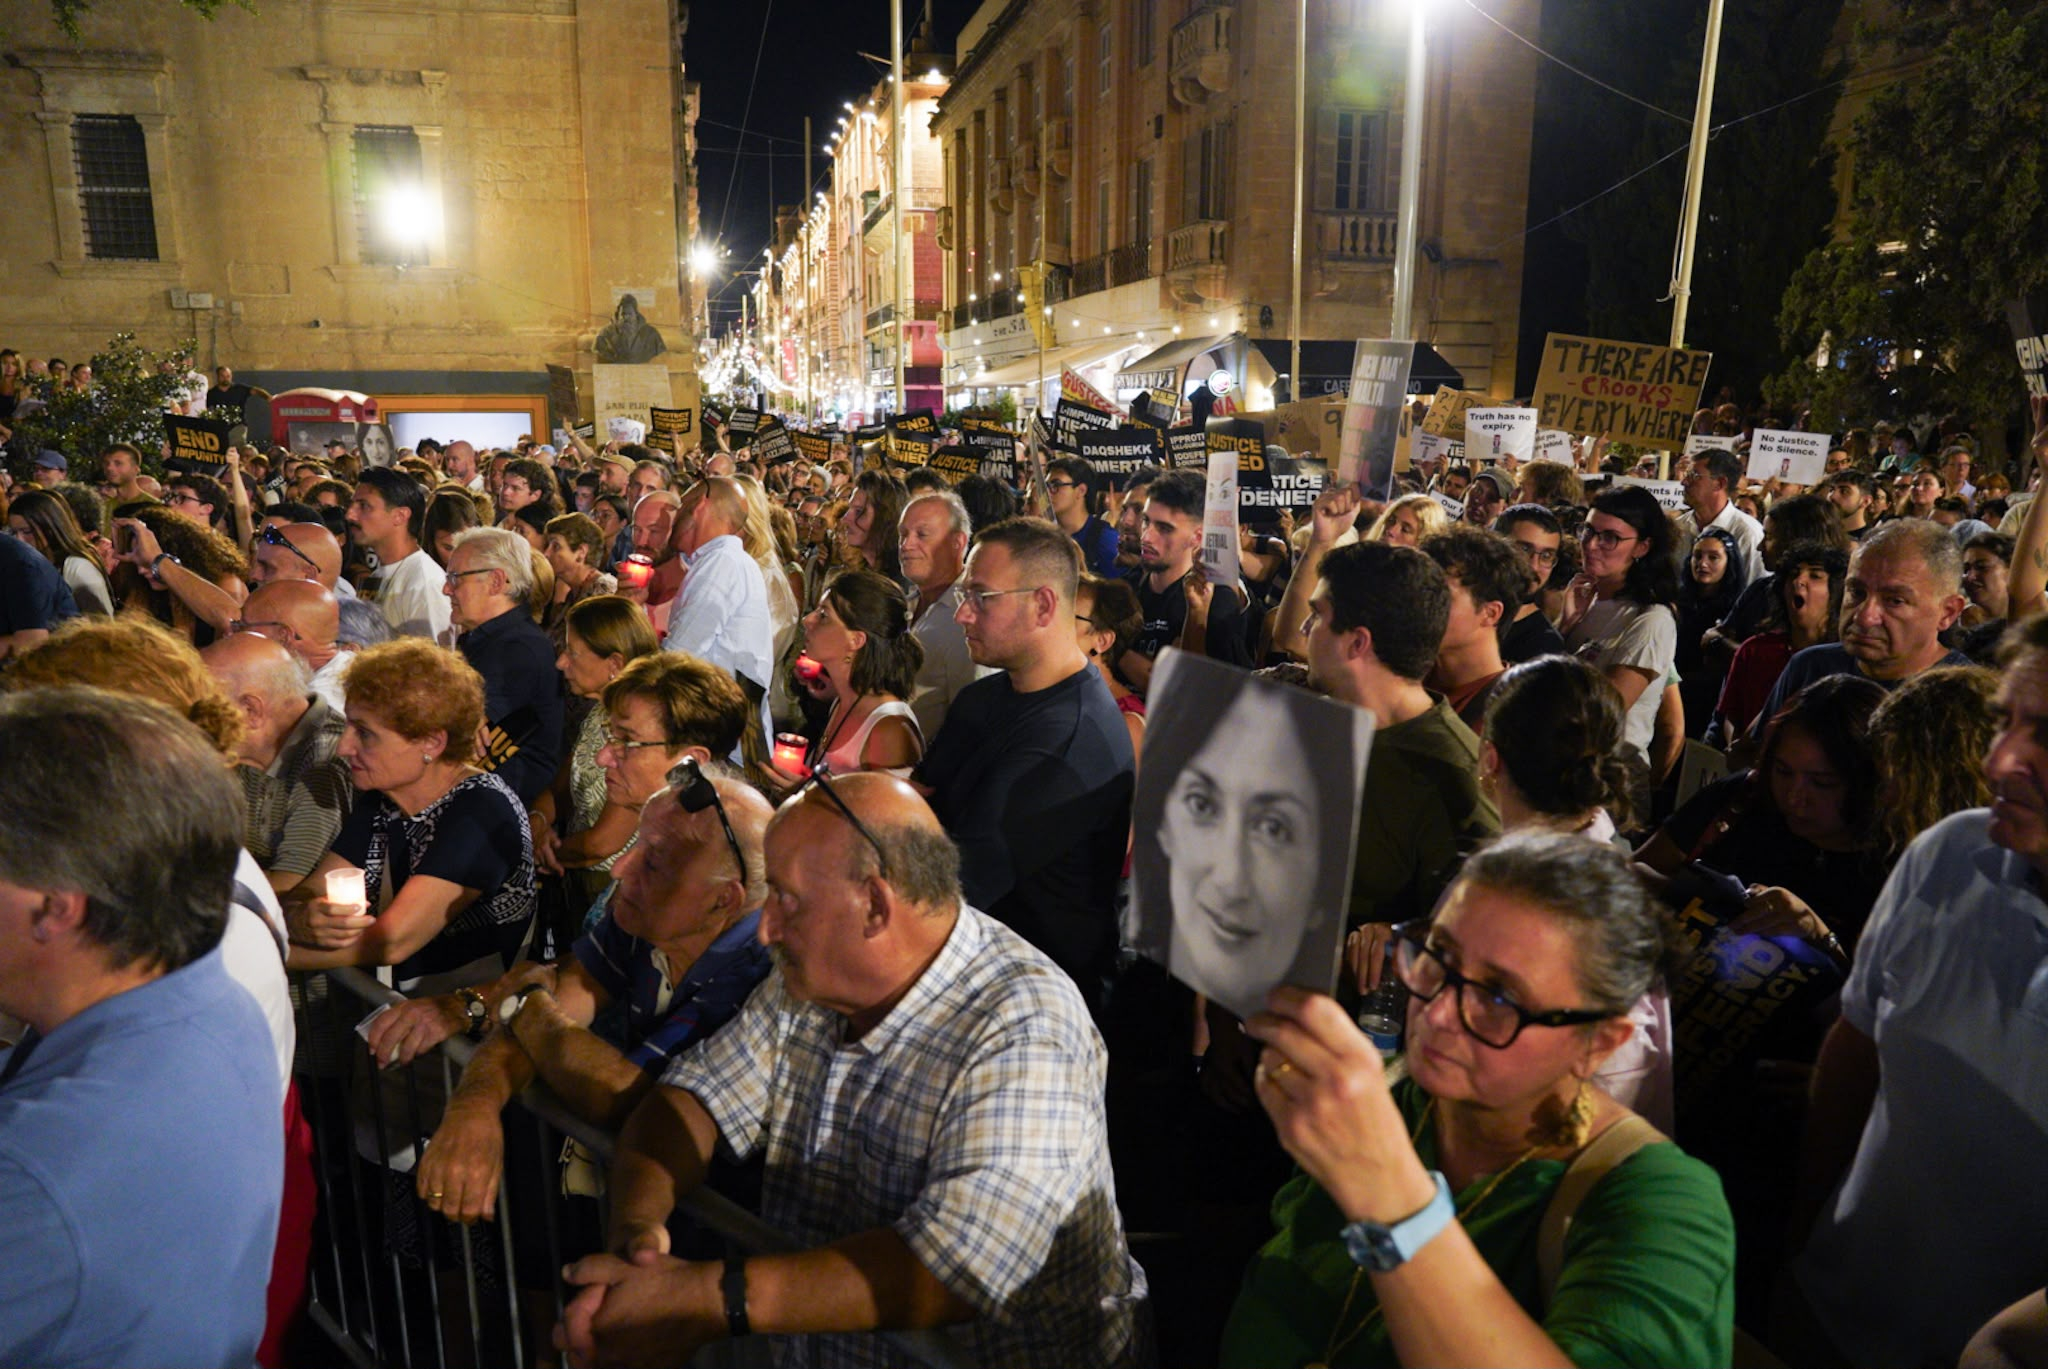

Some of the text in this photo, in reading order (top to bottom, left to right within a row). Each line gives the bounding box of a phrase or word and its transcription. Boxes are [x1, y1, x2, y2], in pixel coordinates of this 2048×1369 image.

[1553, 339, 1709, 386] THERE ARE
[1470, 413, 1495, 421] Truth
[1497, 413, 1516, 421] has
[1540, 392, 1693, 442] EVERYWHERE
[1482, 422, 1515, 432] expiry.
[176, 428, 220, 451] END
[1207, 432, 1261, 453] JUSTICE
[1761, 434, 1820, 447] No Justice.
[176, 449, 226, 466] IMPUNITY
[1082, 444, 1152, 457] DAQSHEKK
[1759, 444, 1818, 457] No Silence.
[931, 454, 979, 473] JUSTICE
[1241, 490, 1321, 506] DENIED
[1441, 499, 1456, 510] Our
